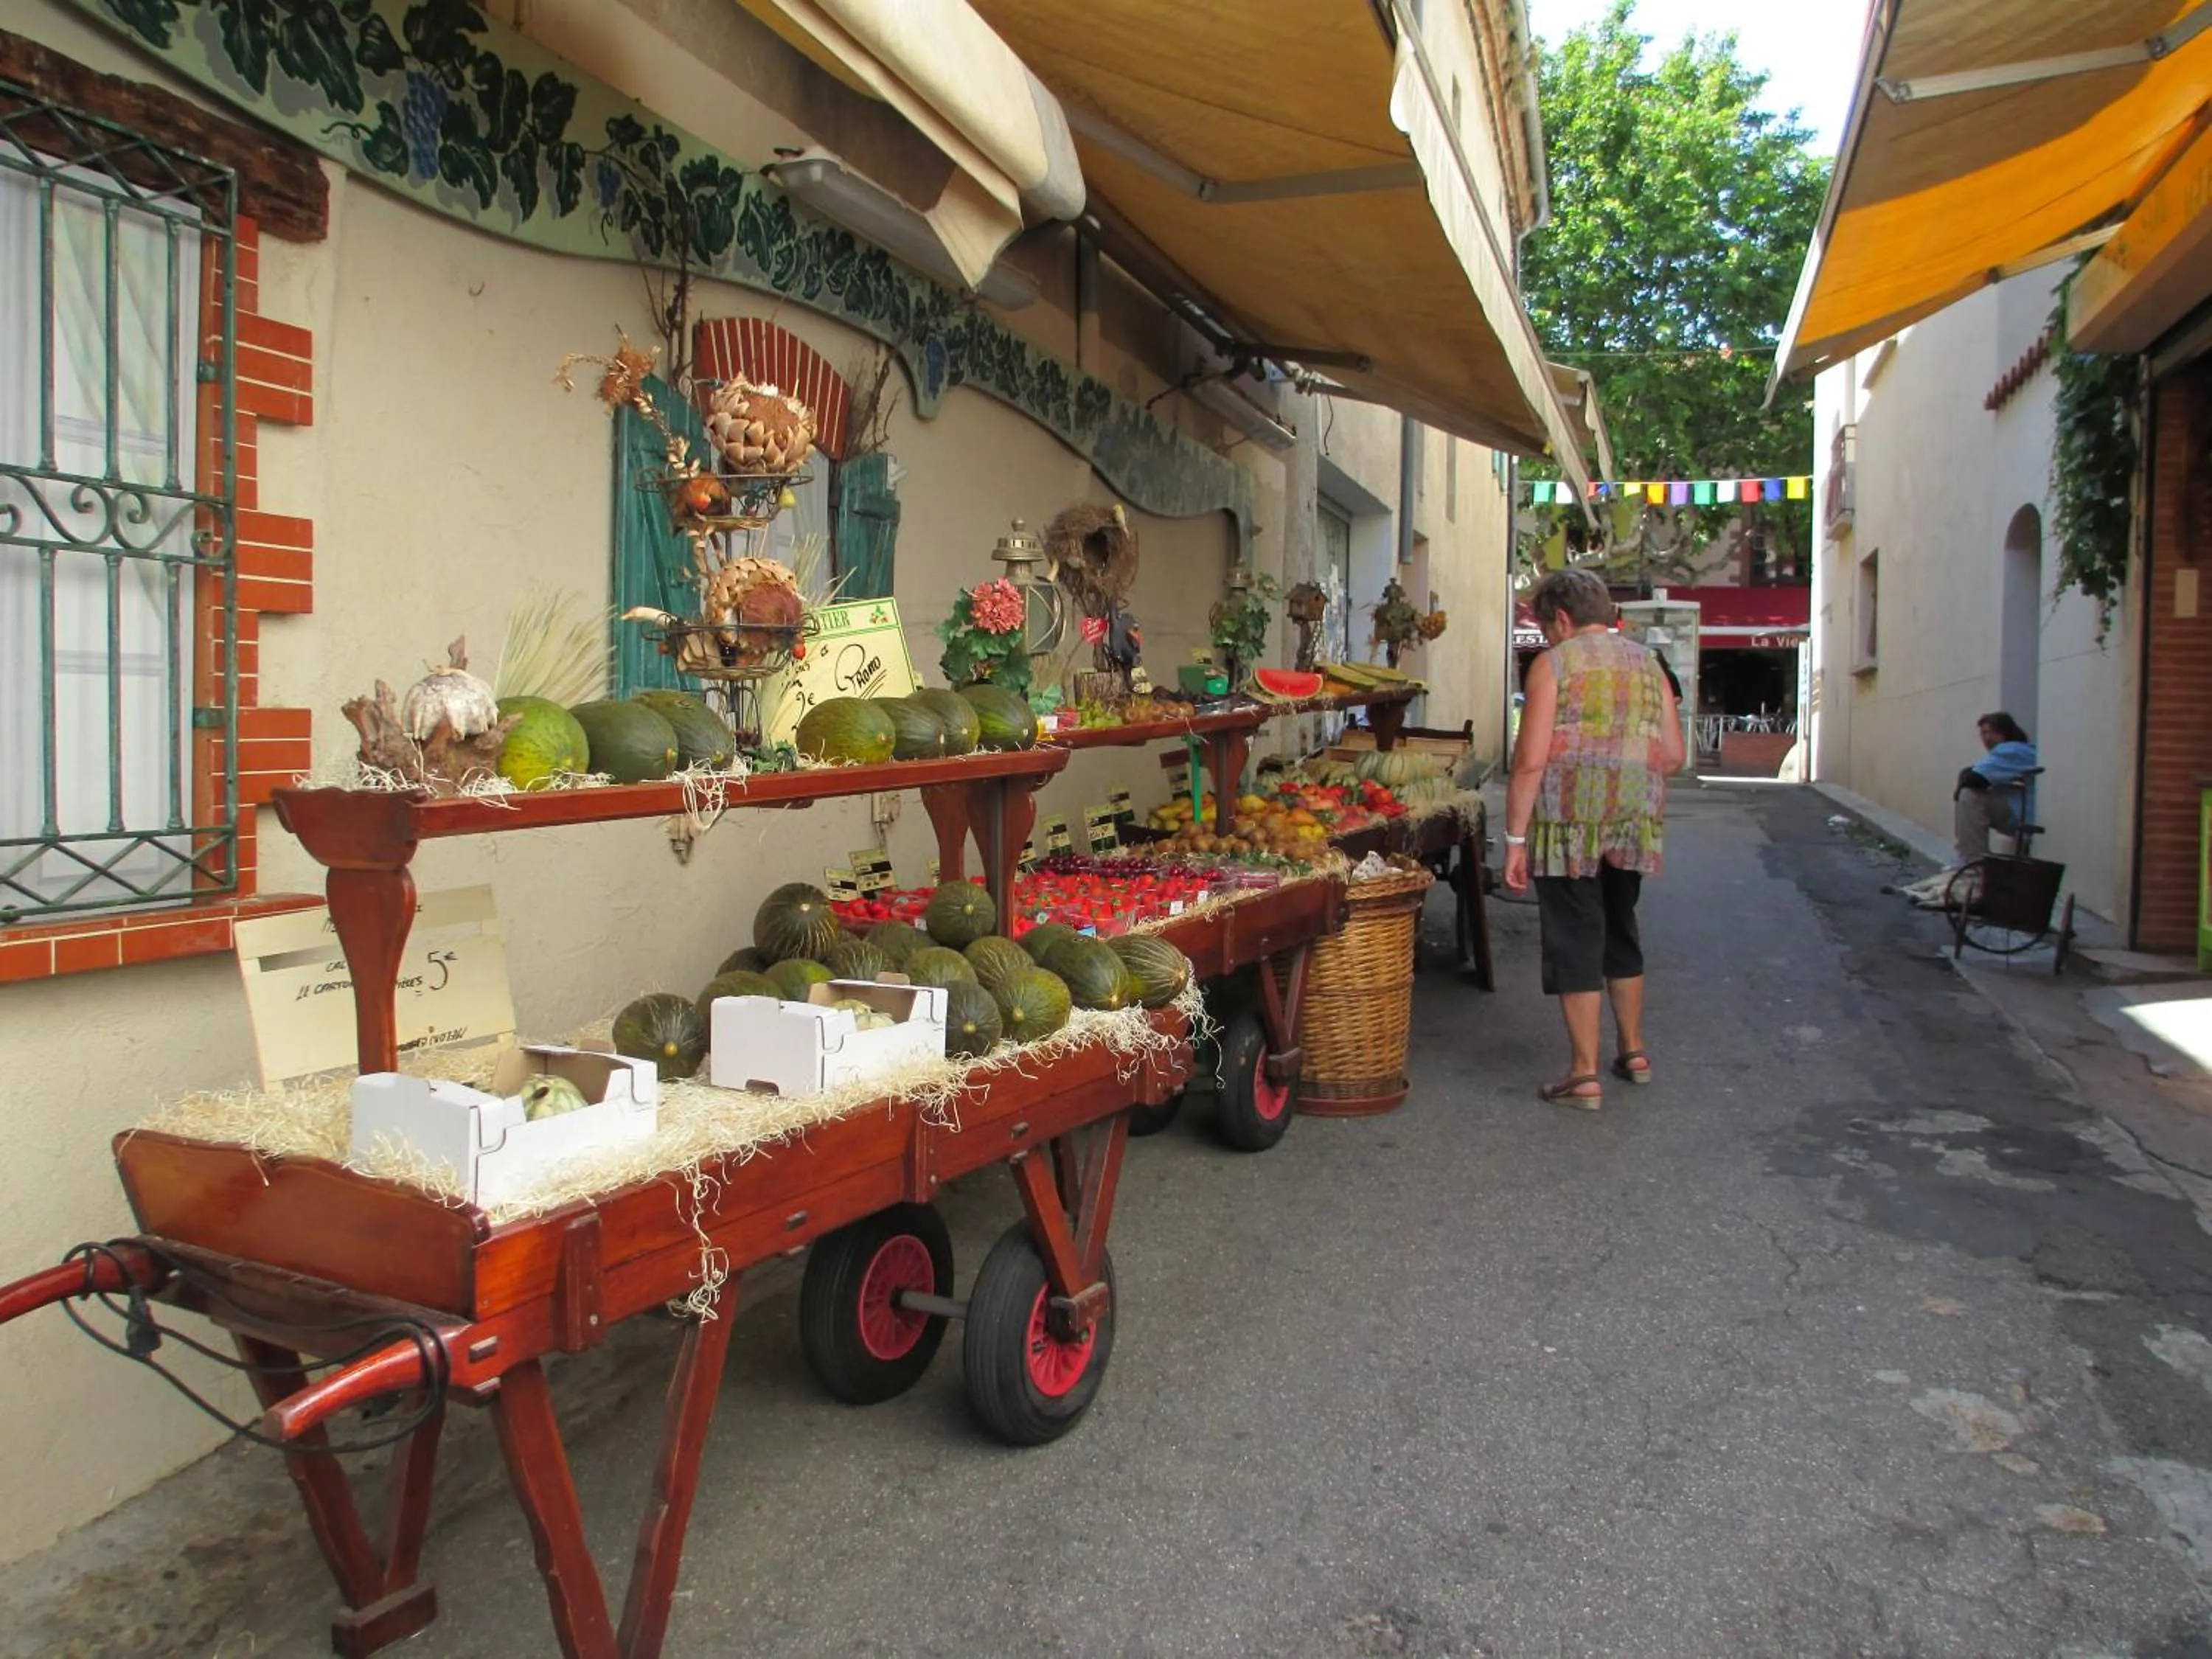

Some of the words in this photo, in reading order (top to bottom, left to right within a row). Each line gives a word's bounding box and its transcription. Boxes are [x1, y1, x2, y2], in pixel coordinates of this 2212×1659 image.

[818, 609, 851, 630] TIER
[1513, 635, 1548, 644] EST
[314, 981, 353, 995] CARTO
